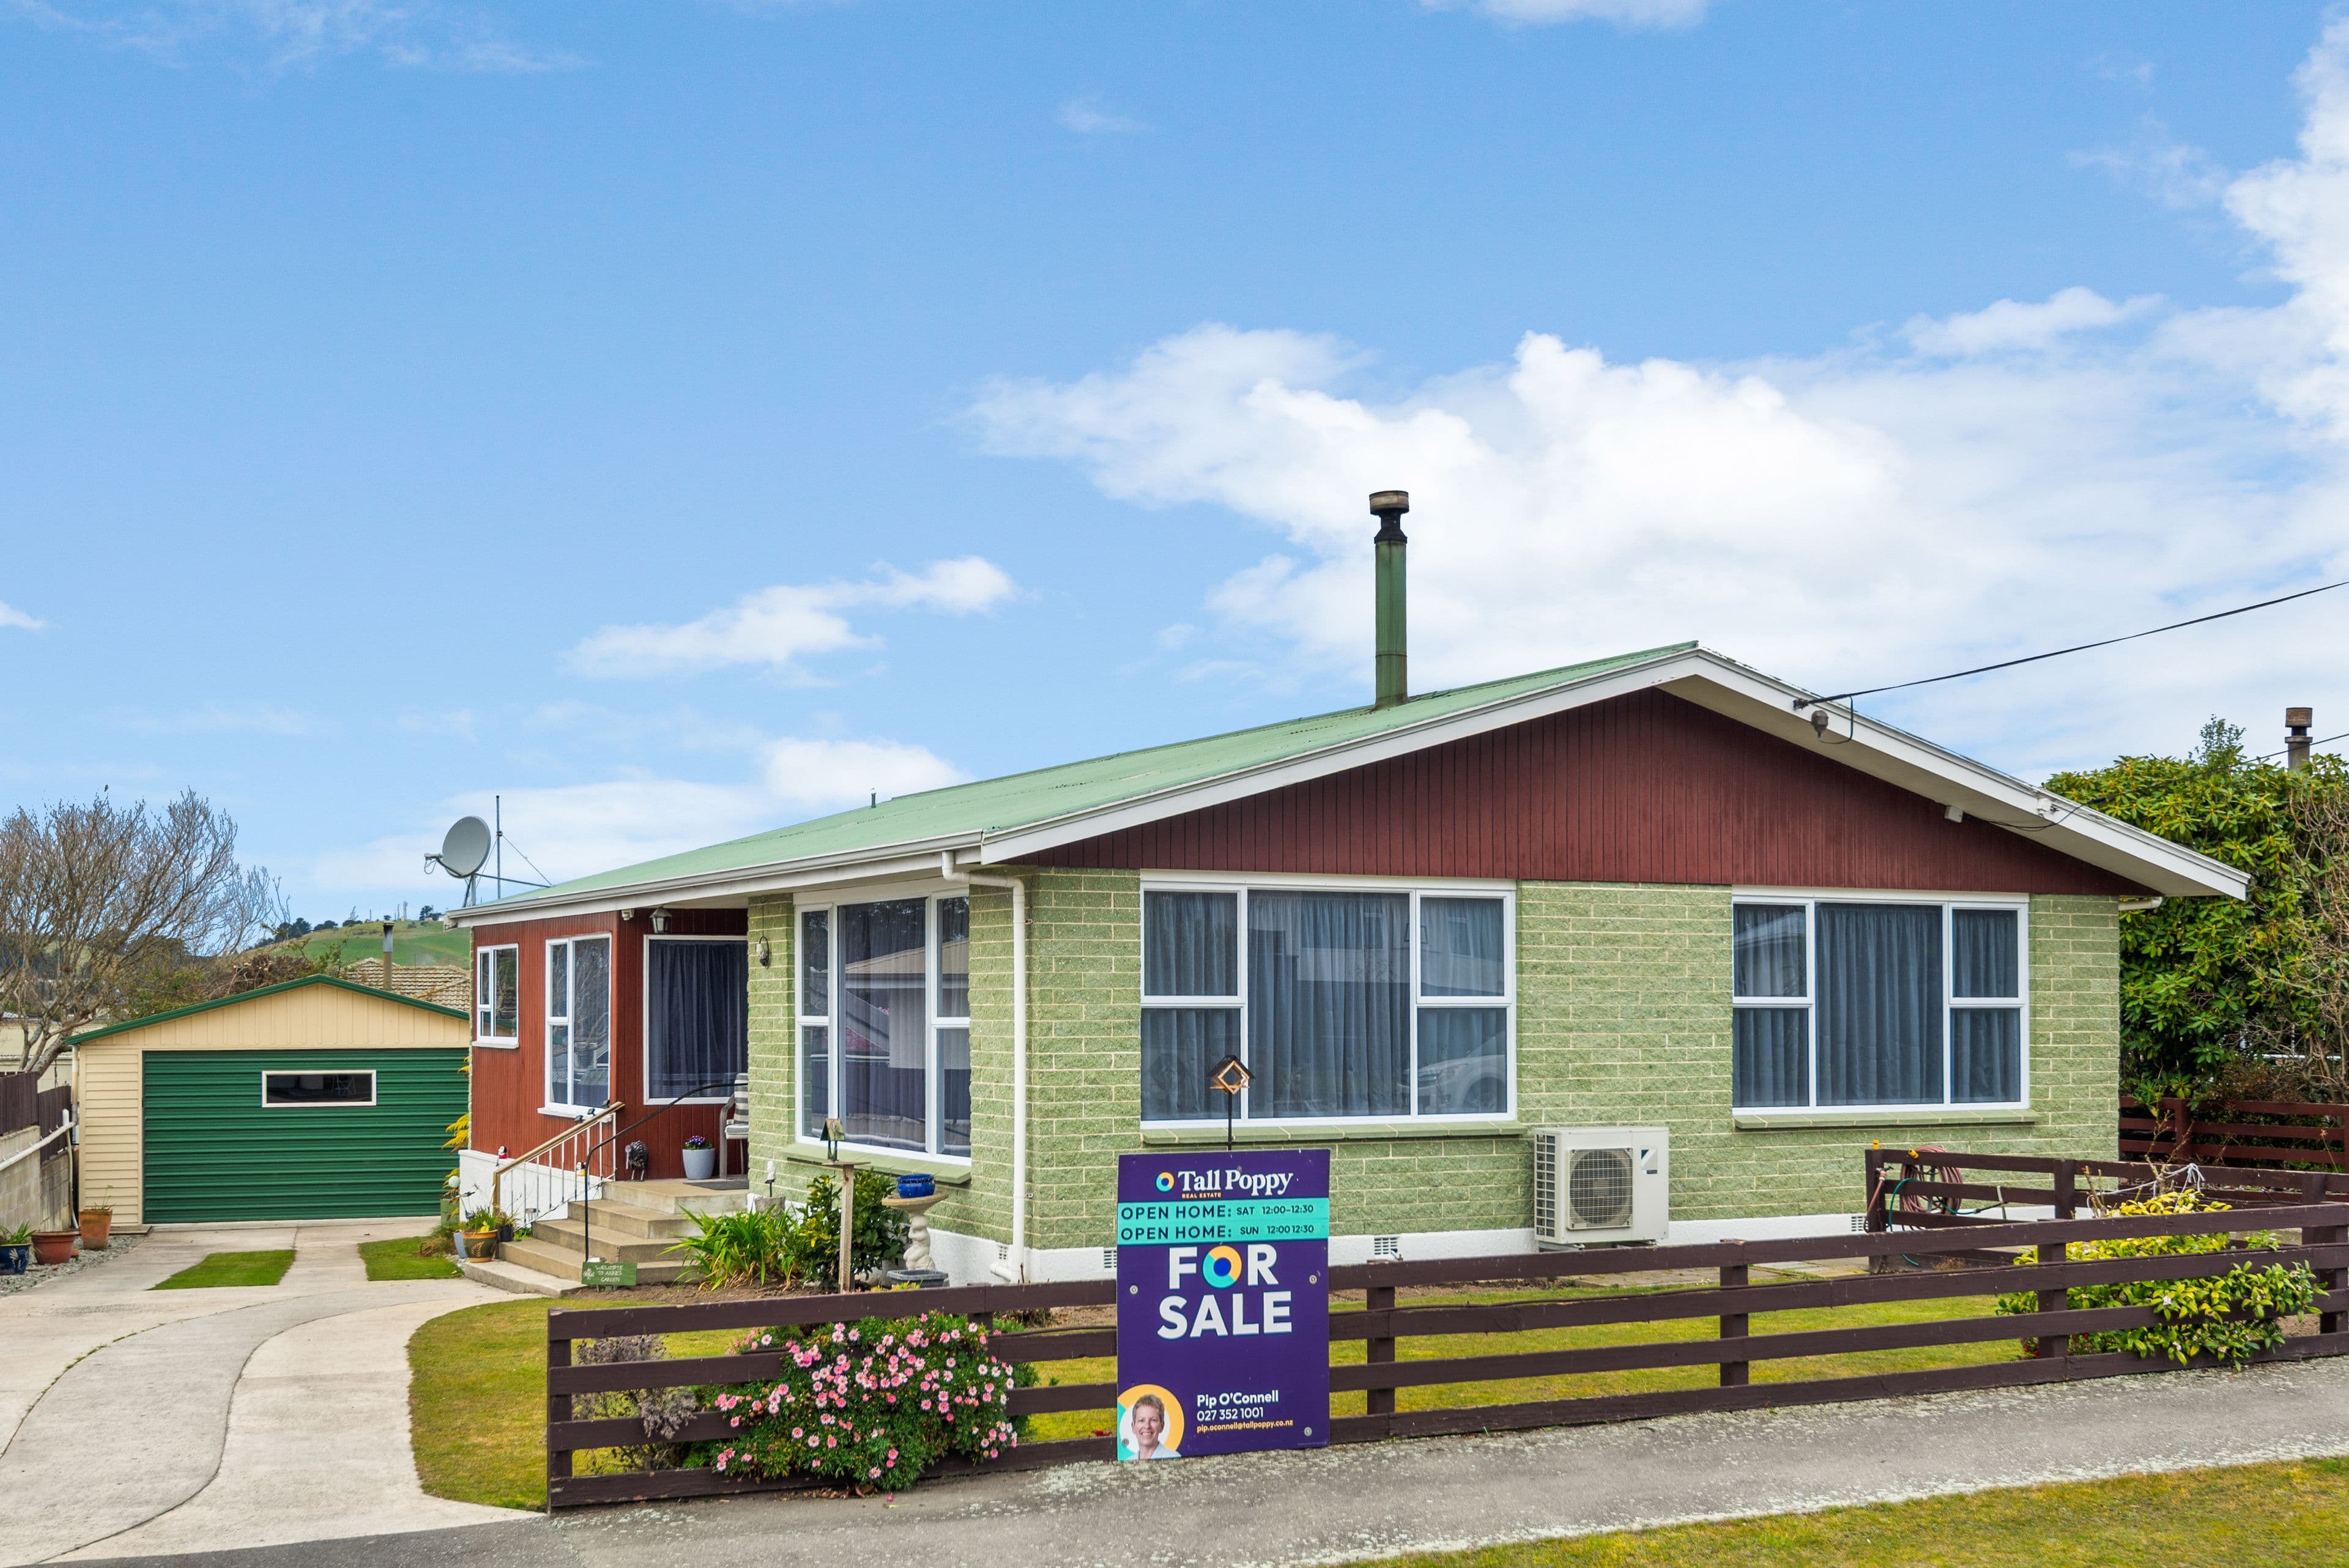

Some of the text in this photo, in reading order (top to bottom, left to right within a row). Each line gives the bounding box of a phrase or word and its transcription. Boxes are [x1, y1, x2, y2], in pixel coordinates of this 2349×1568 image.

[1178, 1169, 1294, 1196] Tall Poppy
[1121, 1206, 1168, 1220] OPEN
[1176, 1205, 1231, 1219] HOME:
[1236, 1206, 1255, 1216] SAT
[1121, 1227, 1168, 1240] OPEN
[1176, 1225, 1231, 1239] HOME:
[1240, 1226, 1259, 1235] SUN
[1169, 1244, 1279, 1289] FOR
[1157, 1291, 1292, 1339] SALE
[1197, 1389, 1279, 1409] Pip O'Connell
[1197, 1406, 1264, 1422] 027 352 1001
[1197, 1419, 1294, 1433] pip.oconnell@tallpoppy.co.nz
